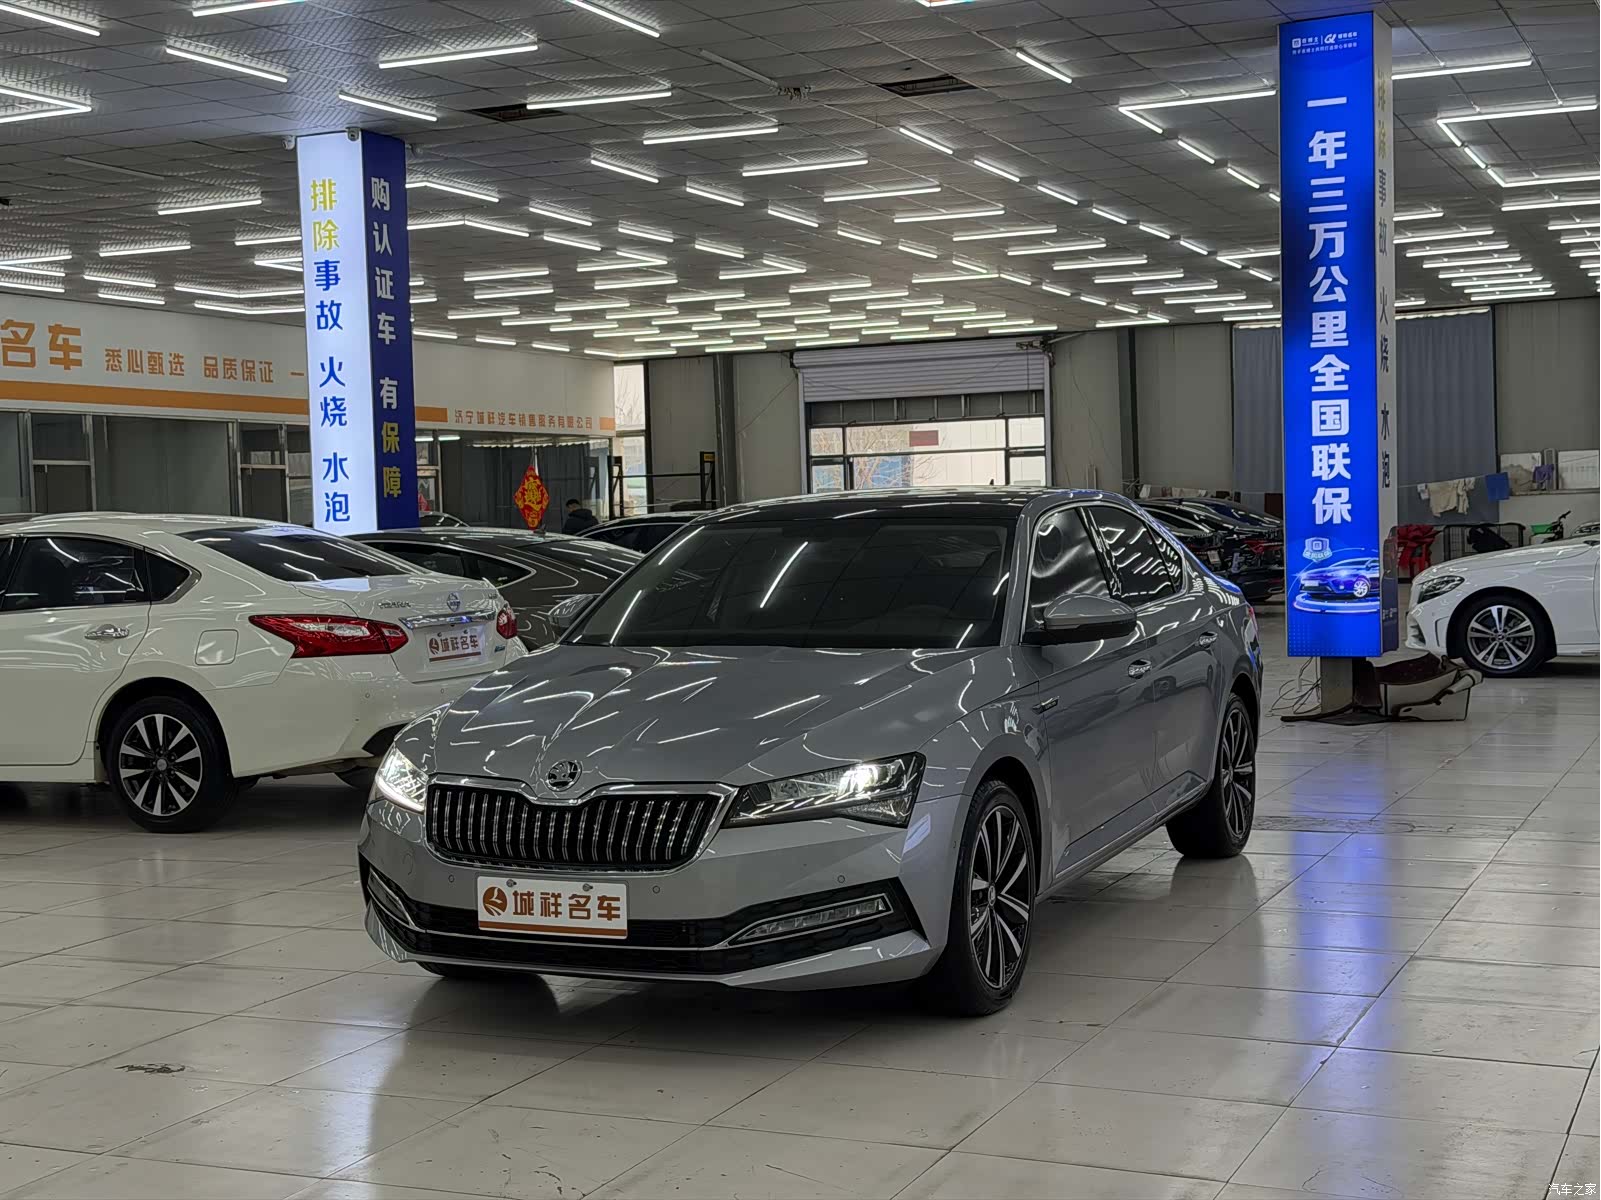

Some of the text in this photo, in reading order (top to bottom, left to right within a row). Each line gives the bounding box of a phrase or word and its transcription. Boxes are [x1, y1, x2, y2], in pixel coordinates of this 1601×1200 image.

[0, 319, 83, 370] 名车
[370, 176, 402, 498] 购认证车 有保障
[1306, 96, 1352, 525] 一年三万公里全国联保
[1379, 286, 1389, 373] 火烧
[104, 347, 186, 377] 悉心甄选
[203, 355, 275, 383] 品质保证
[311, 178, 351, 522] 排除事故 火烧 水泡
[454, 408, 593, 430] 济宁城祥汽车销售服务有限公司
[1380, 402, 1391, 488] 水泡
[439, 634, 480, 653] 城祥名车
[512, 890, 621, 921] 城祥名车
